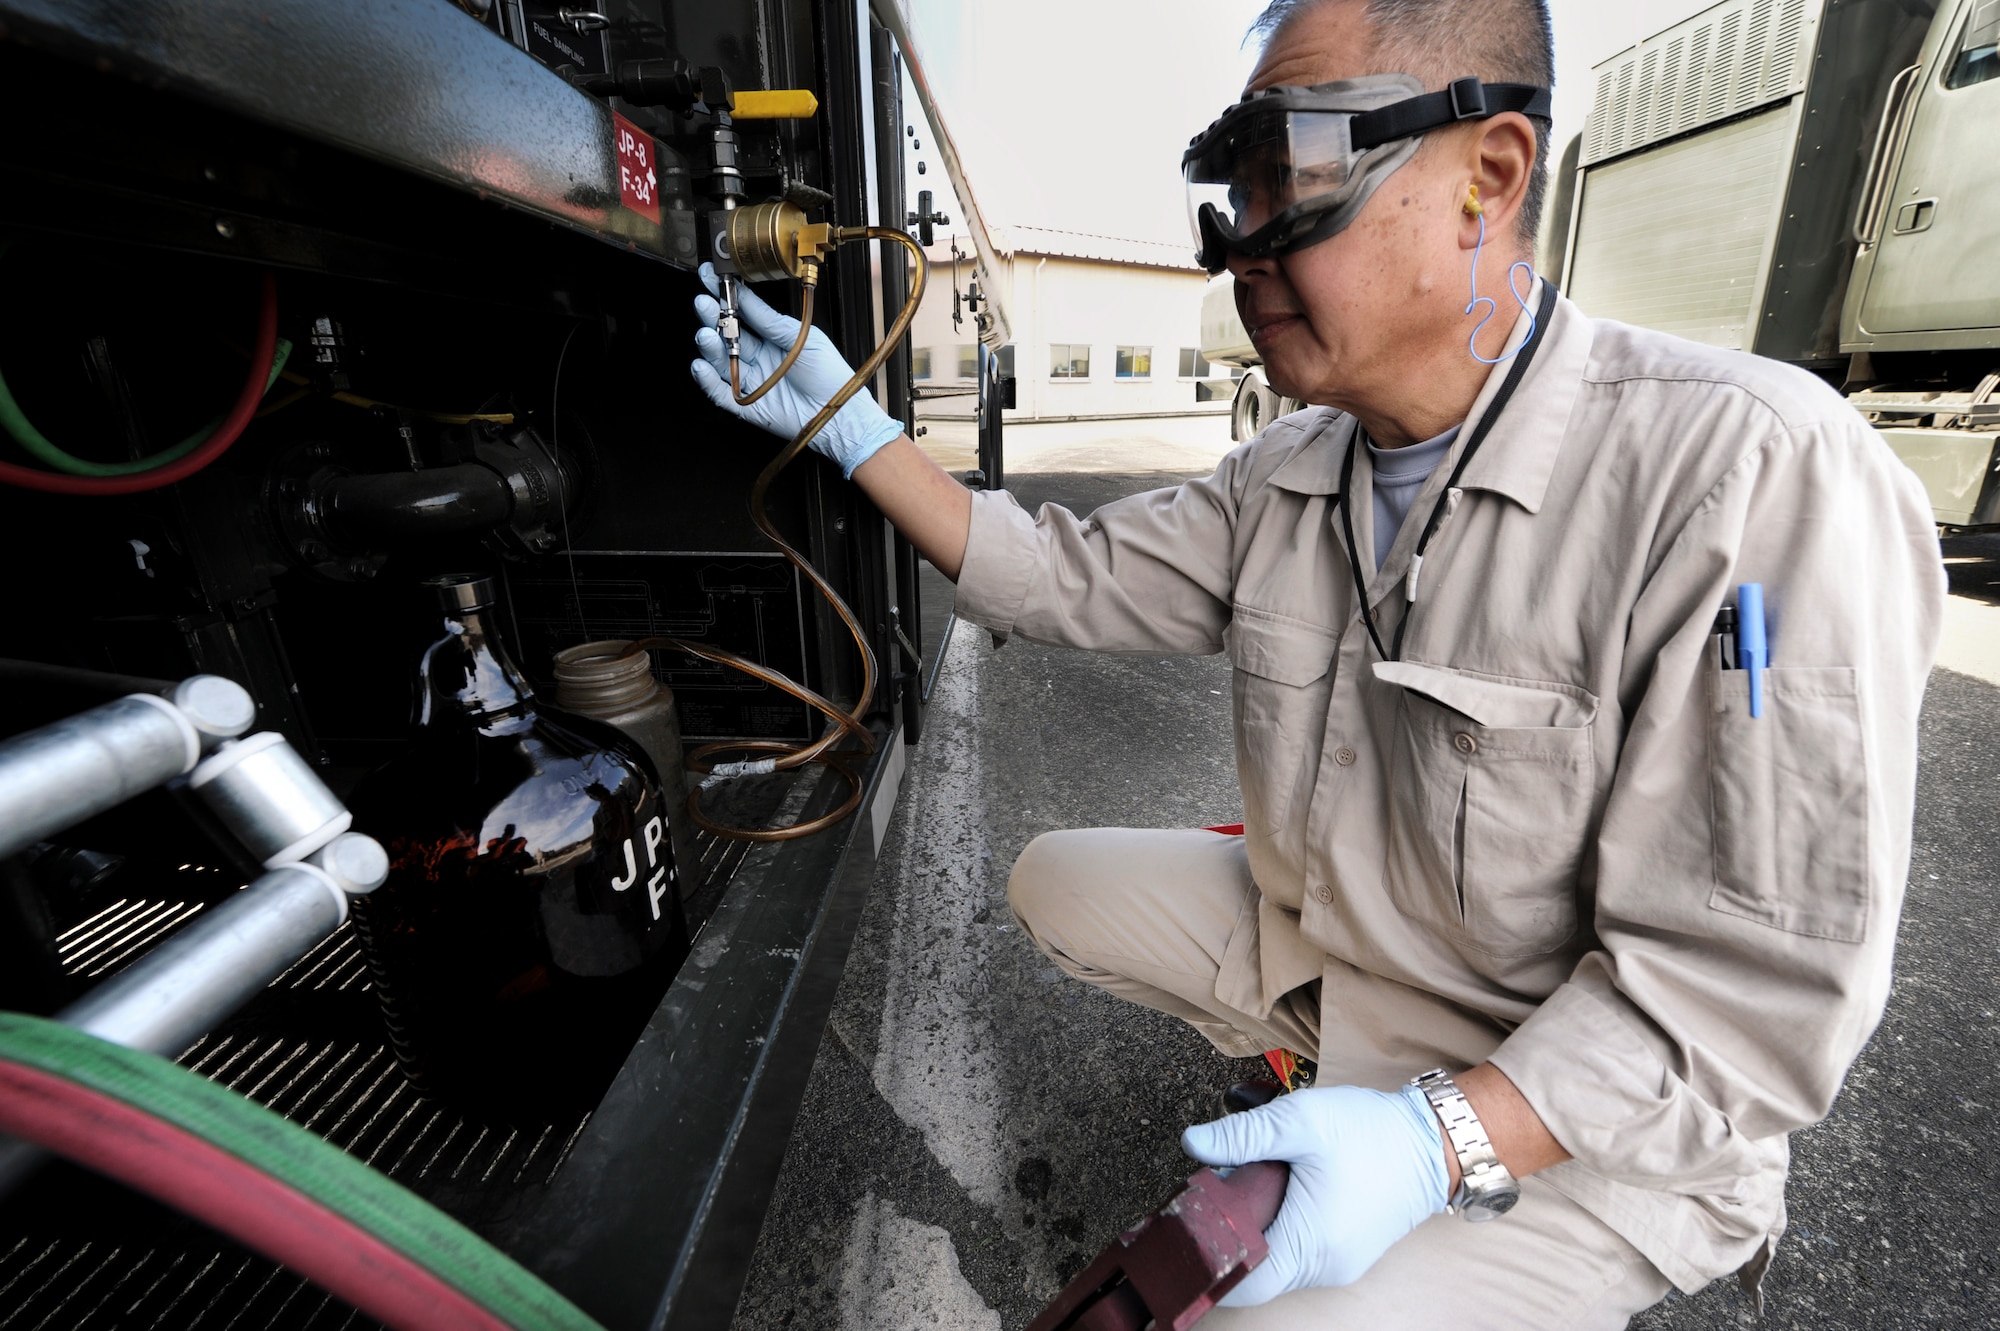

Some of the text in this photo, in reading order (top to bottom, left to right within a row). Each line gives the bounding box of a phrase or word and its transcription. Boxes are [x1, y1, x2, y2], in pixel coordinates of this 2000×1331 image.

[533, 21, 585, 67] FUEL SAMPLING
[618, 129, 647, 167] JP-8
[621, 165, 650, 205] F-34
